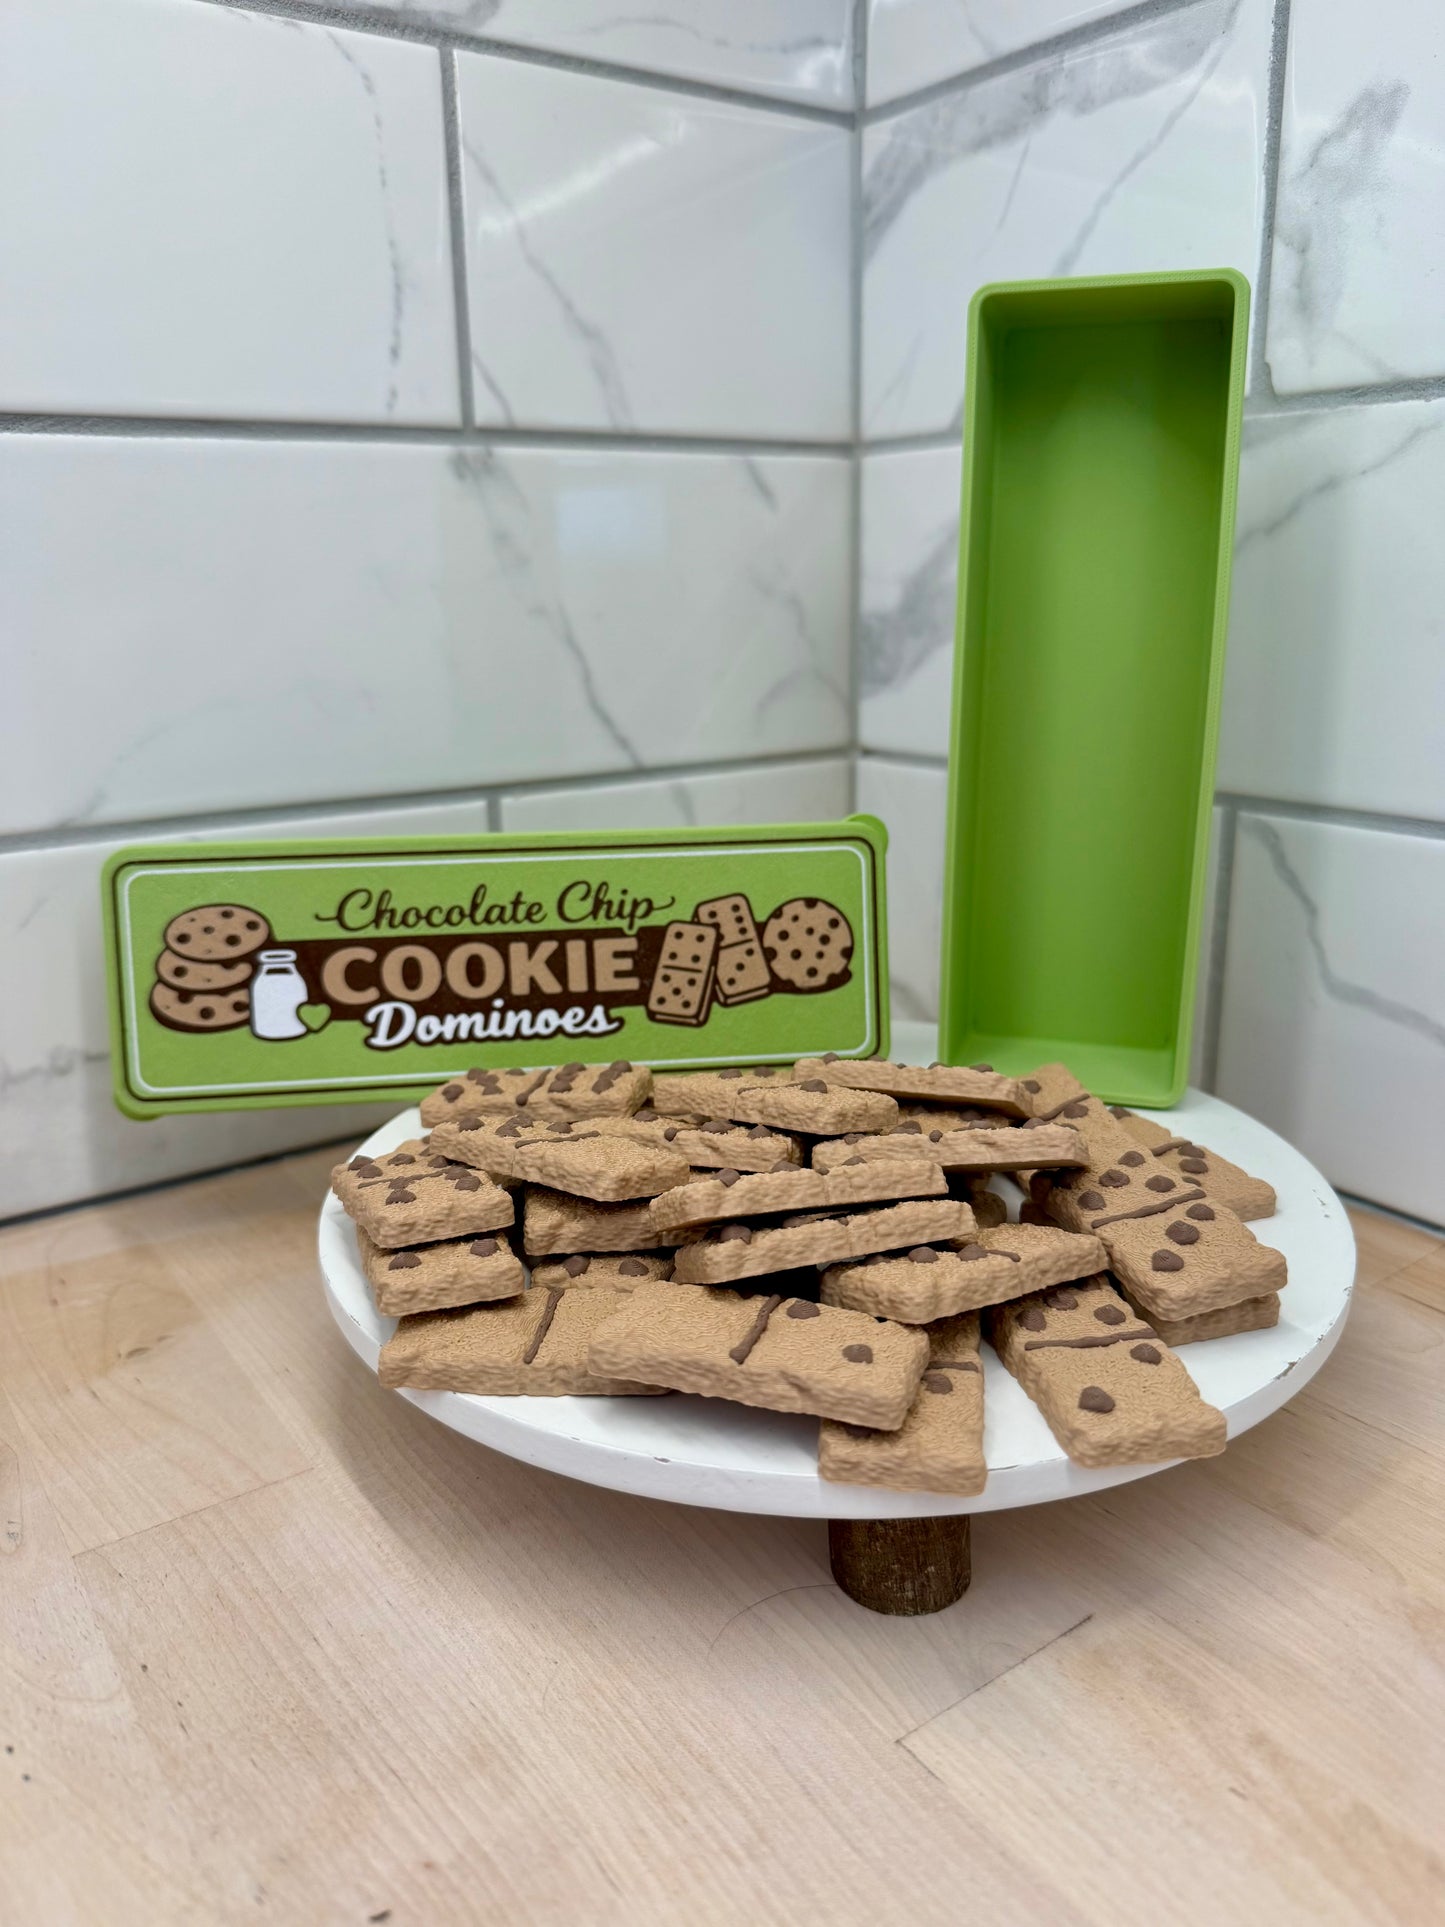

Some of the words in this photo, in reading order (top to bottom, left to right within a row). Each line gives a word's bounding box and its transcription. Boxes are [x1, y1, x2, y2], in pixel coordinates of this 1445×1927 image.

[315, 883, 547, 931] Chocolate
[556, 881, 675, 930] Chip
[322, 937, 640, 1005] COOKIE
[366, 998, 619, 1048] Dominoes
